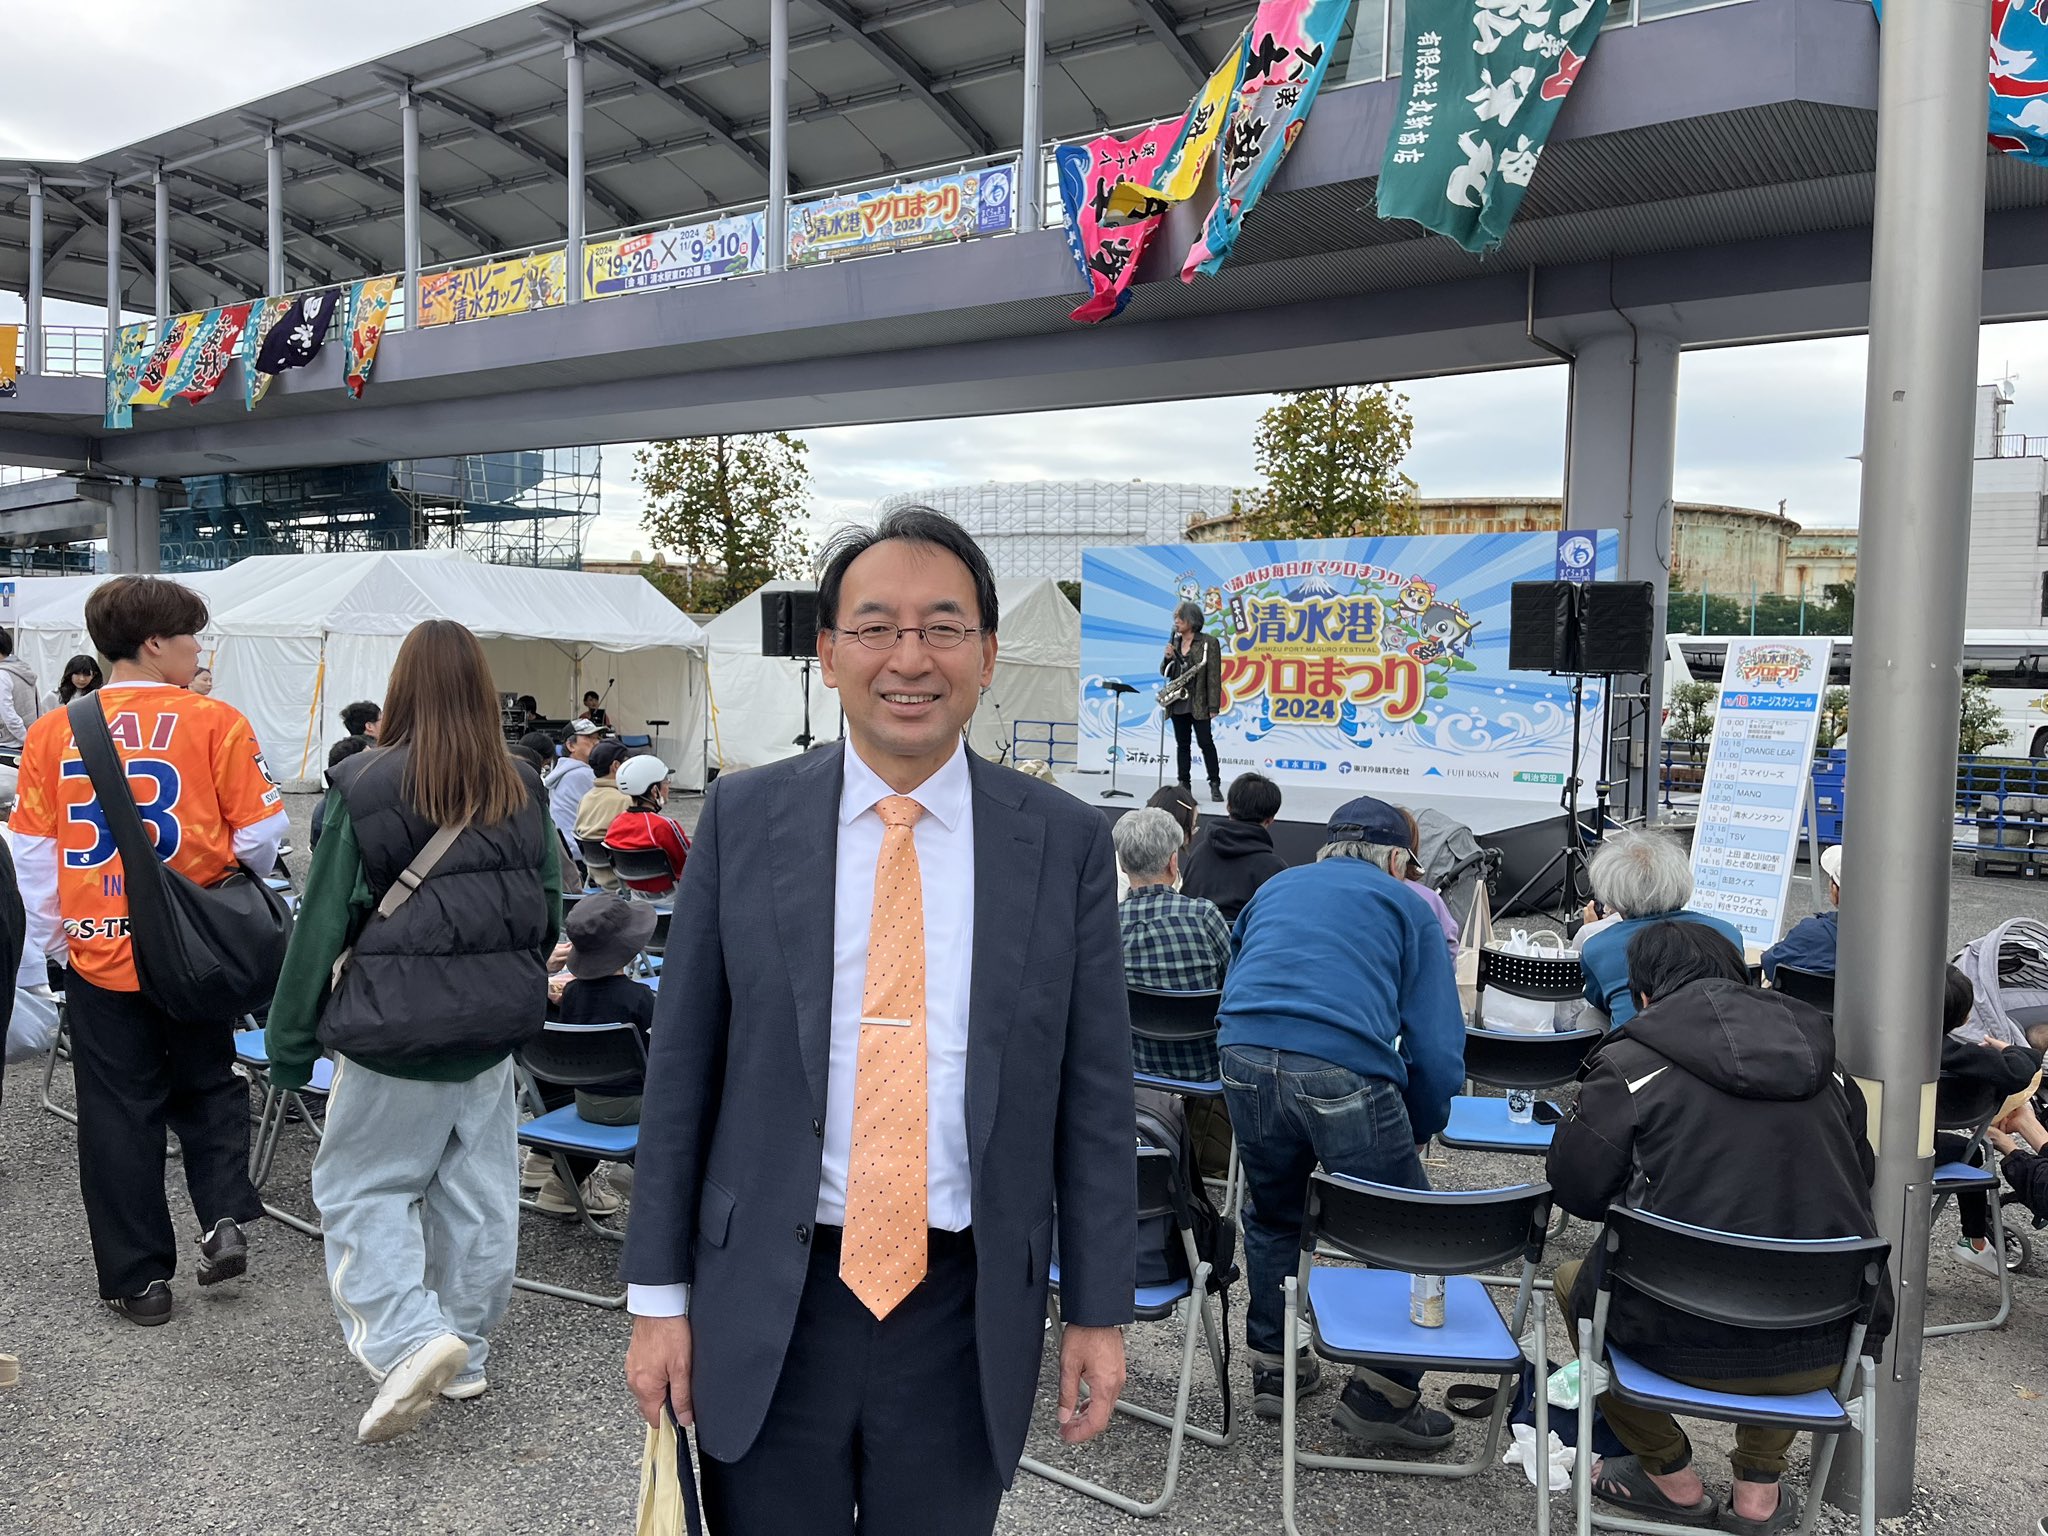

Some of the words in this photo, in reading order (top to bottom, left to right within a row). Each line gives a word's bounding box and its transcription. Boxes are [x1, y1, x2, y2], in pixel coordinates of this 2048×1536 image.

[861, 187, 958, 234] マグロまつり
[808, 211, 861, 242] 清水港
[894, 218, 923, 232] 2024
[680, 229, 700, 240] 2024
[595, 246, 612, 256] 2024
[454, 273, 526, 321] 清水カップ
[1237, 601, 1377, 651] 清水港
[1743, 666, 1798, 681] マグロまつり
[1275, 698, 1335, 718] 2024
[1750, 696, 1813, 708] ステージスケジュール
[1744, 746, 1775, 756] ORANGE
[1777, 748, 1796, 757] LEAF
[1281, 759, 1321, 771] 清水銀行
[1447, 768, 1465, 778] FUJI
[1467, 769, 1500, 779] BUSSAN
[1521, 773, 1557, 783] 明治安田
[1741, 768, 1784, 779] スマイリーズ
[1733, 811, 1784, 823] 清水ノンタウン
[1730, 832, 1746, 841] TSV
[1726, 850, 1741, 858] 上田
[1720, 893, 1762, 906] マグロクイズ
